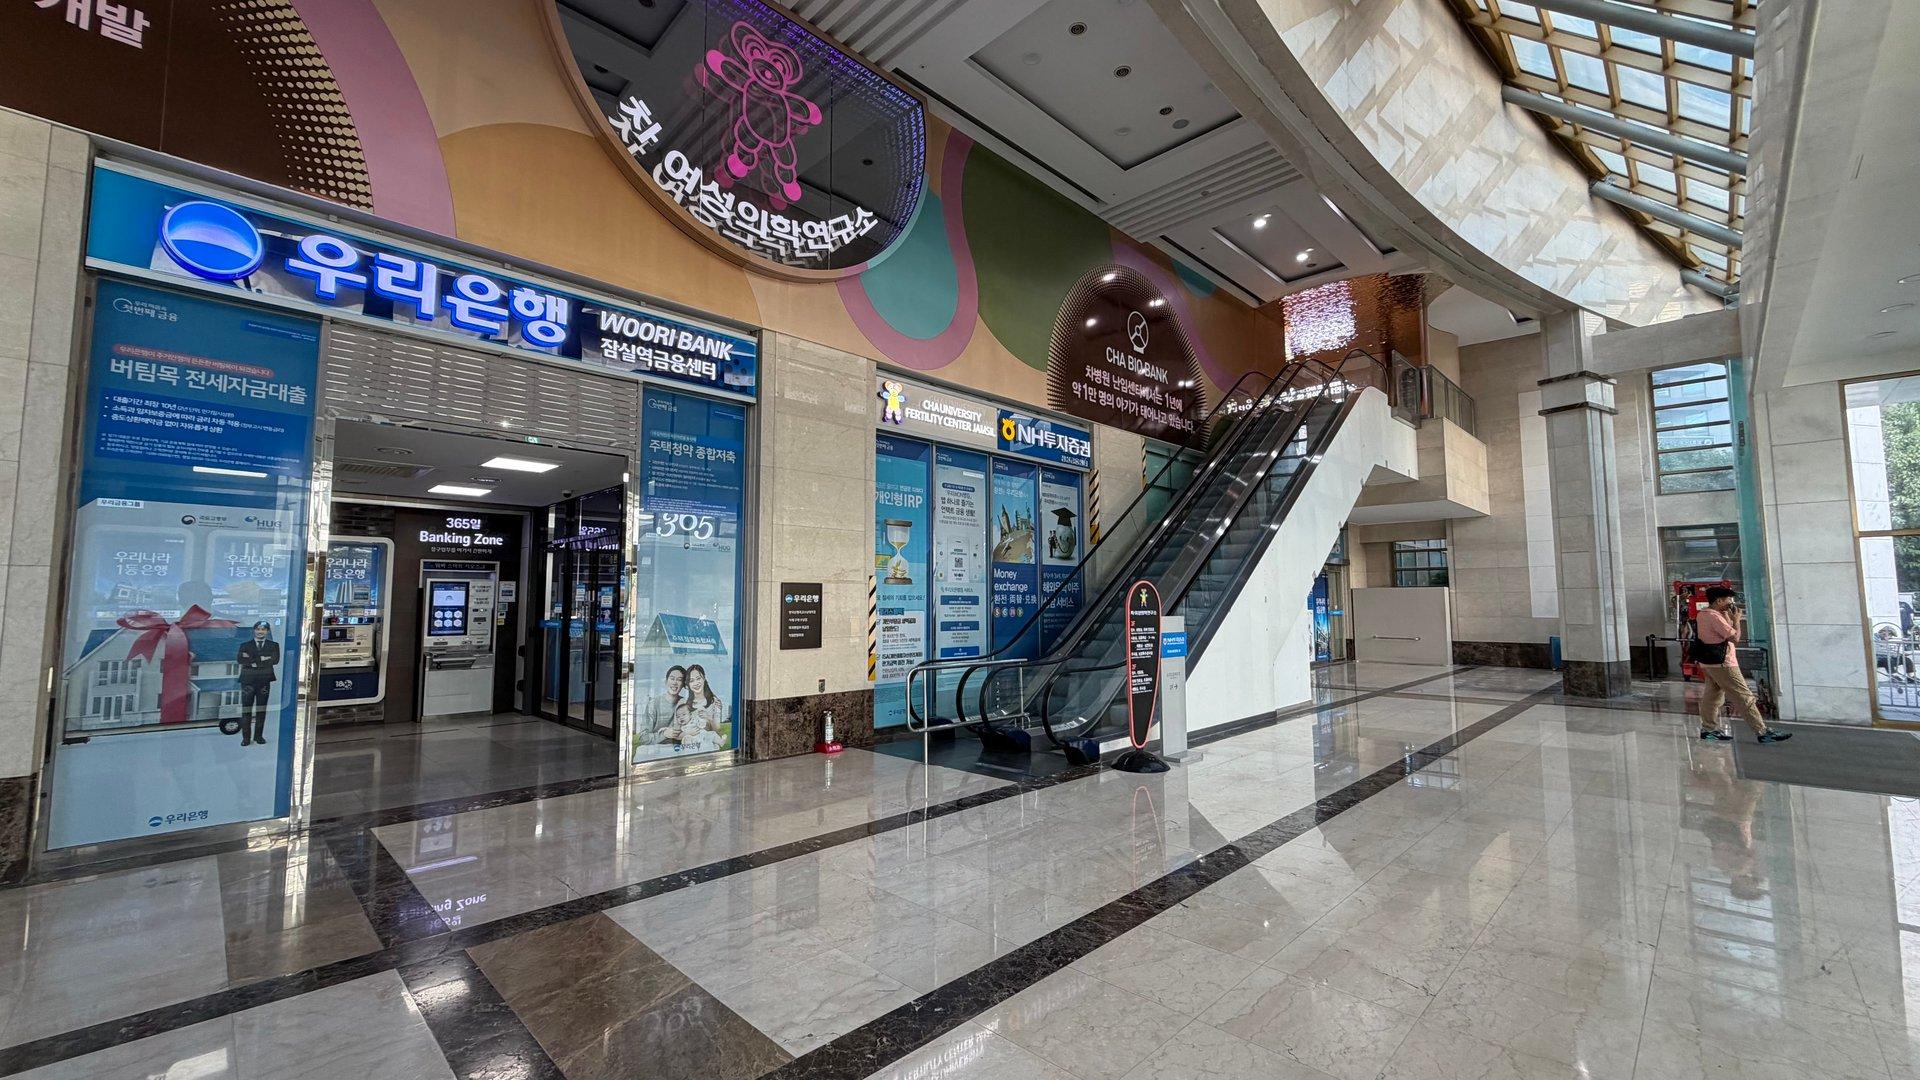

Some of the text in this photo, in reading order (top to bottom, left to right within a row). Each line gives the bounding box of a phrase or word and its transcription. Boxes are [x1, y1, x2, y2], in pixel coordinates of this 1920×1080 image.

[886, 80, 918, 104] CENTER
[662, 149, 879, 251] 여성의학연구소
[284, 234, 568, 347] 우리은행
[600, 310, 734, 361] WOORI BANK
[600, 337, 717, 381] 잠실역금융센터
[1106, 346, 1127, 369] CHA
[1144, 362, 1169, 384] BANK
[110, 359, 308, 405] 버팀목 전세자금대출
[1085, 364, 1110, 387] 차병원
[113, 396, 143, 406] 대출기간
[144, 400, 160, 408] 최장
[161, 402, 176, 411] 10년
[922, 399, 982, 423] CHA UNIVERSITY
[1071, 381, 1081, 399] 약
[1082, 382, 1098, 403] 1만
[1098, 390, 1114, 408] 명의
[1115, 396, 1139, 417] 아기가
[1140, 404, 1168, 425] 태어나고
[112, 405, 135, 414] 소득과
[180, 413, 196, 422] 따라
[905, 407, 998, 437] FERTILITY CENTER JAMSIL
[164, 420, 179, 429] 없이
[179, 422, 208, 432] 자유롭게
[208, 426, 223, 434] 상환
[1017, 423, 1091, 458] NH투자증권
[649, 439, 737, 464] 주택청약 종합저축
[904, 494, 923, 508] IRP
[256, 520, 282, 529] HUG
[445, 517, 482, 530] 365일
[419, 530, 503, 547] Banking Zone
[113, 551, 173, 565] 우리나라
[226, 554, 277, 568] 우리나라
[993, 568, 1018, 580] Money
[994, 582, 1029, 594] exchange
[794, 594, 819, 603] 우리은행
[165, 810, 208, 824] 우리은행
